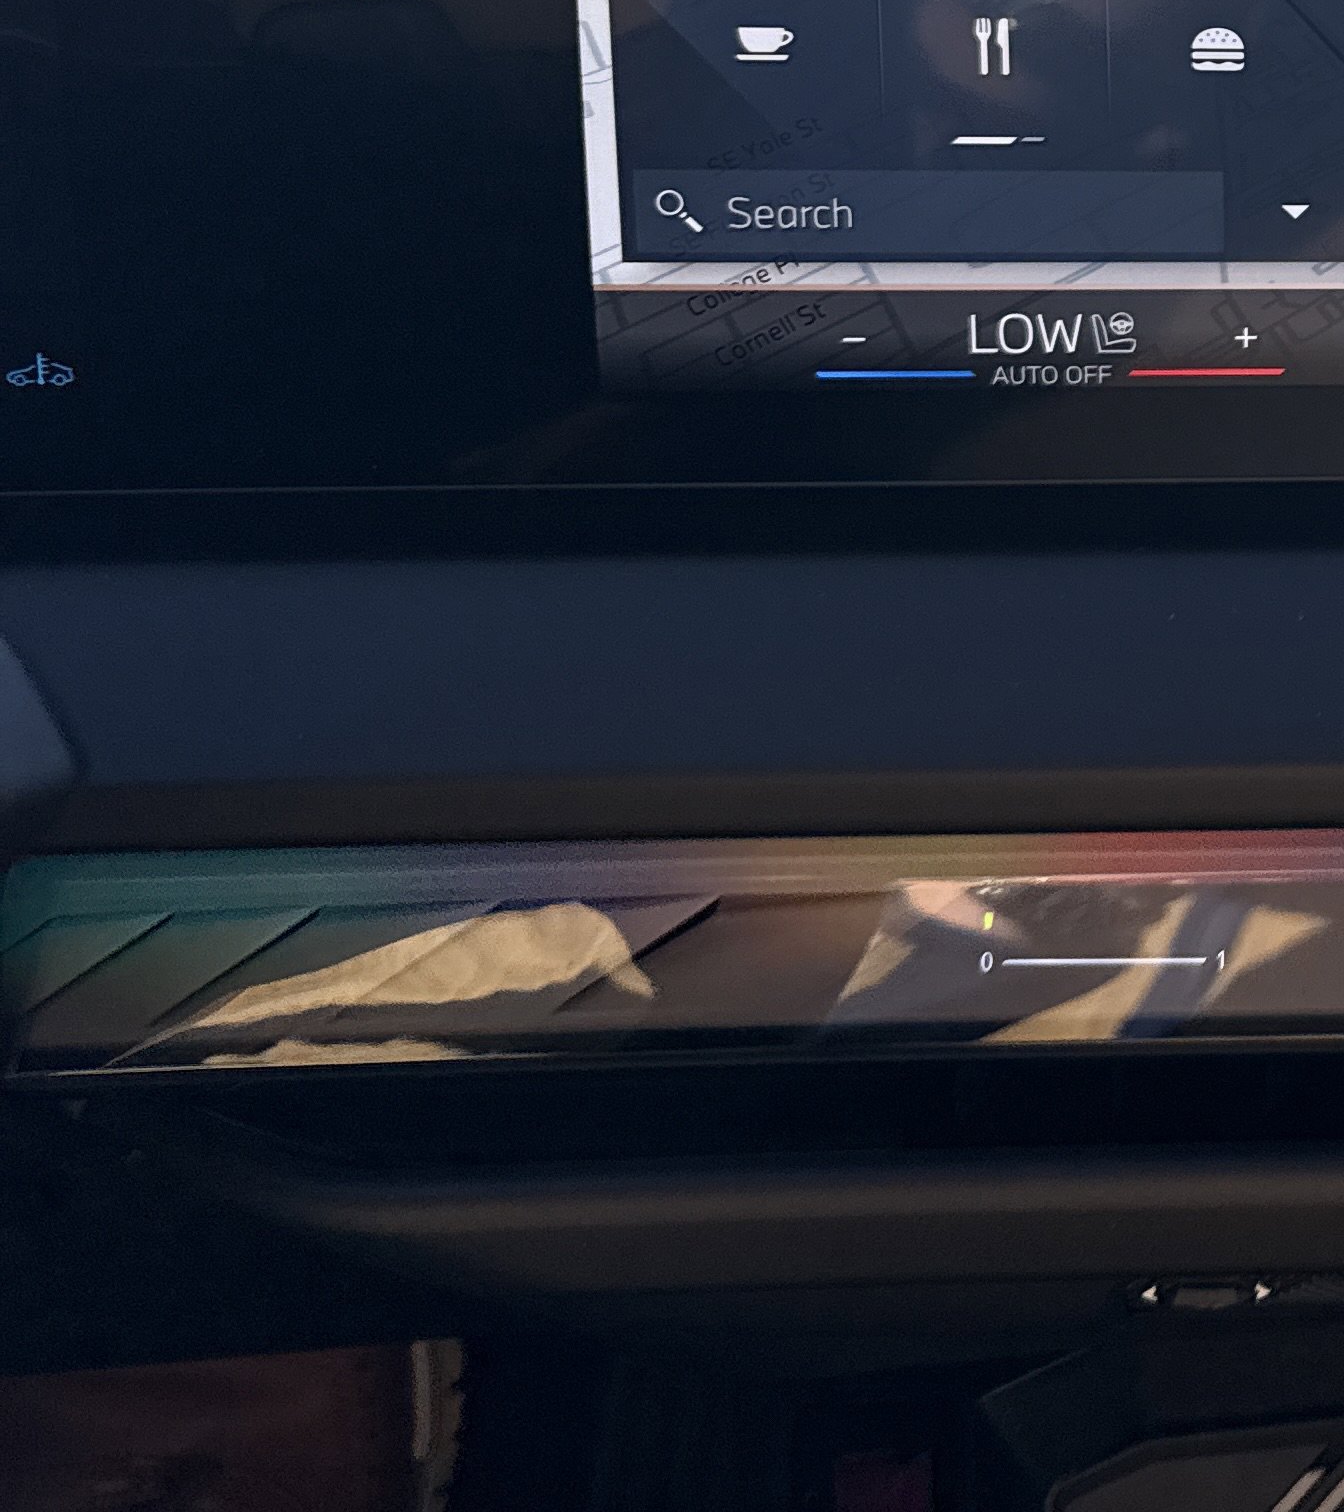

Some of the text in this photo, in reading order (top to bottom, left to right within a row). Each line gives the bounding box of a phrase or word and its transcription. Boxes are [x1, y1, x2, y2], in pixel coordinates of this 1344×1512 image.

[727, 196, 853, 229] Search
[970, 312, 1083, 354] LOW
[991, 364, 1113, 385] AUTO OFF
